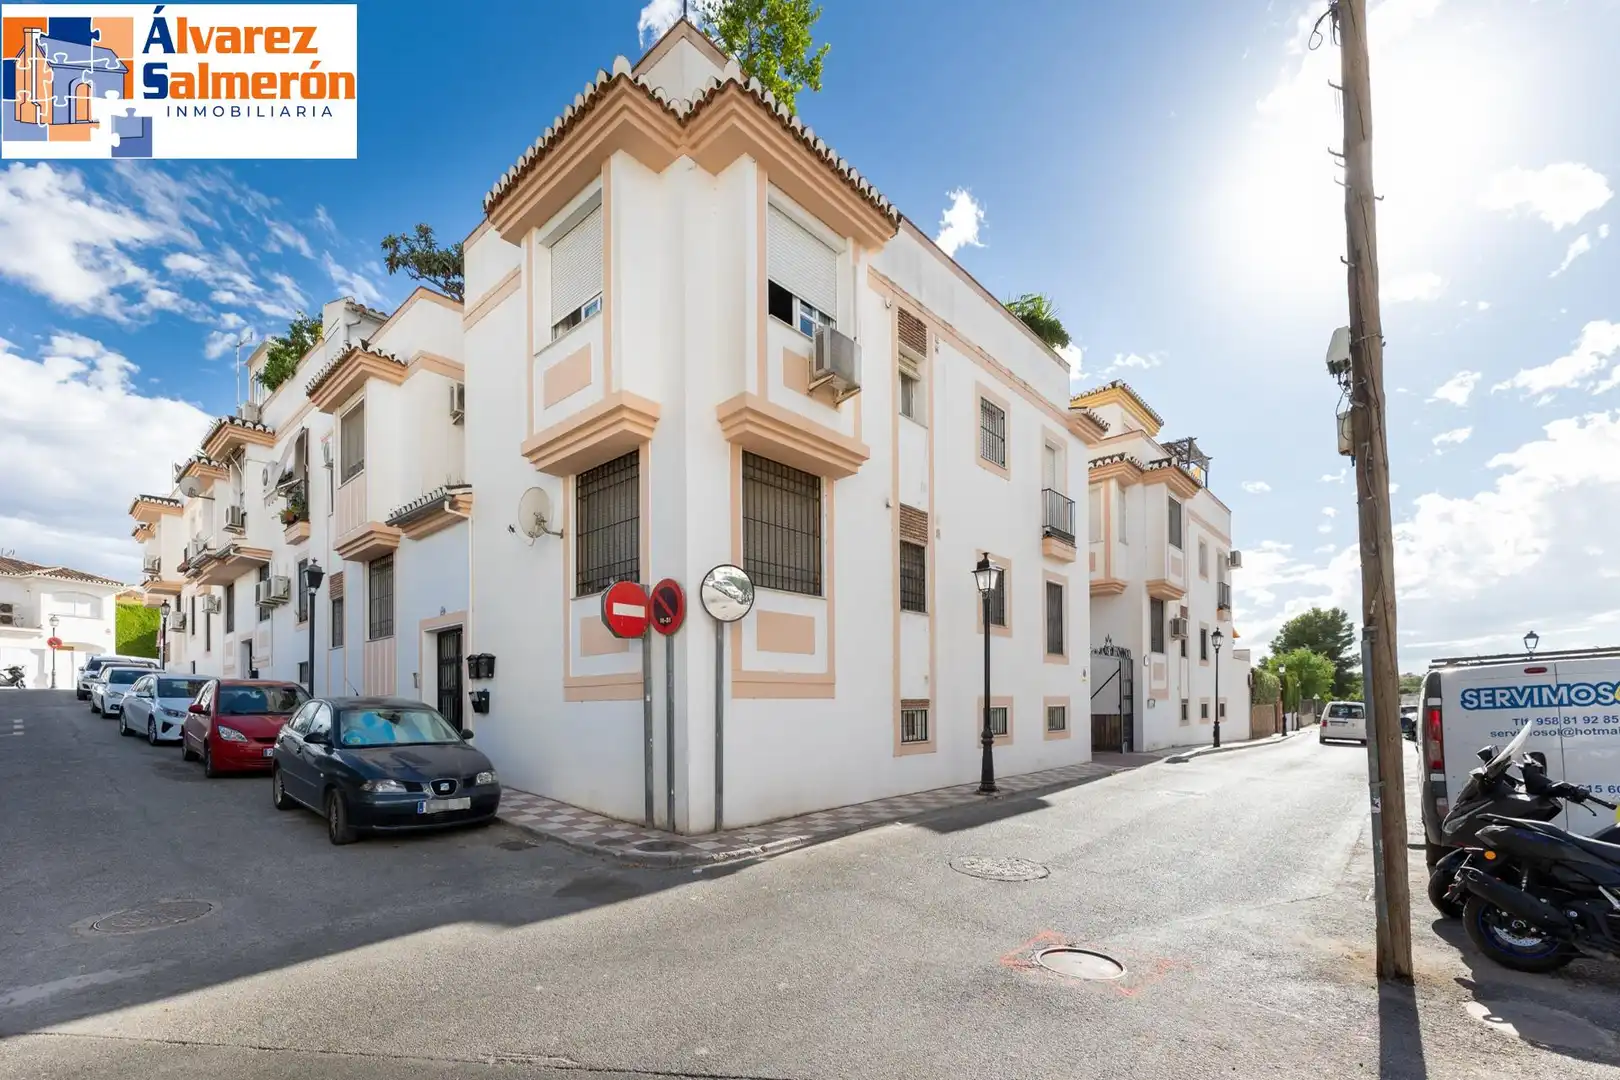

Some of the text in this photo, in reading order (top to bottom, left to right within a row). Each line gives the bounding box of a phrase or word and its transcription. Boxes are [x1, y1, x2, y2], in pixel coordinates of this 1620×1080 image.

[1536, 717, 1559, 726] 958
[1563, 716, 1577, 725] 81
[1582, 715, 1599, 724] 92
[1603, 715, 1619, 724] 85
